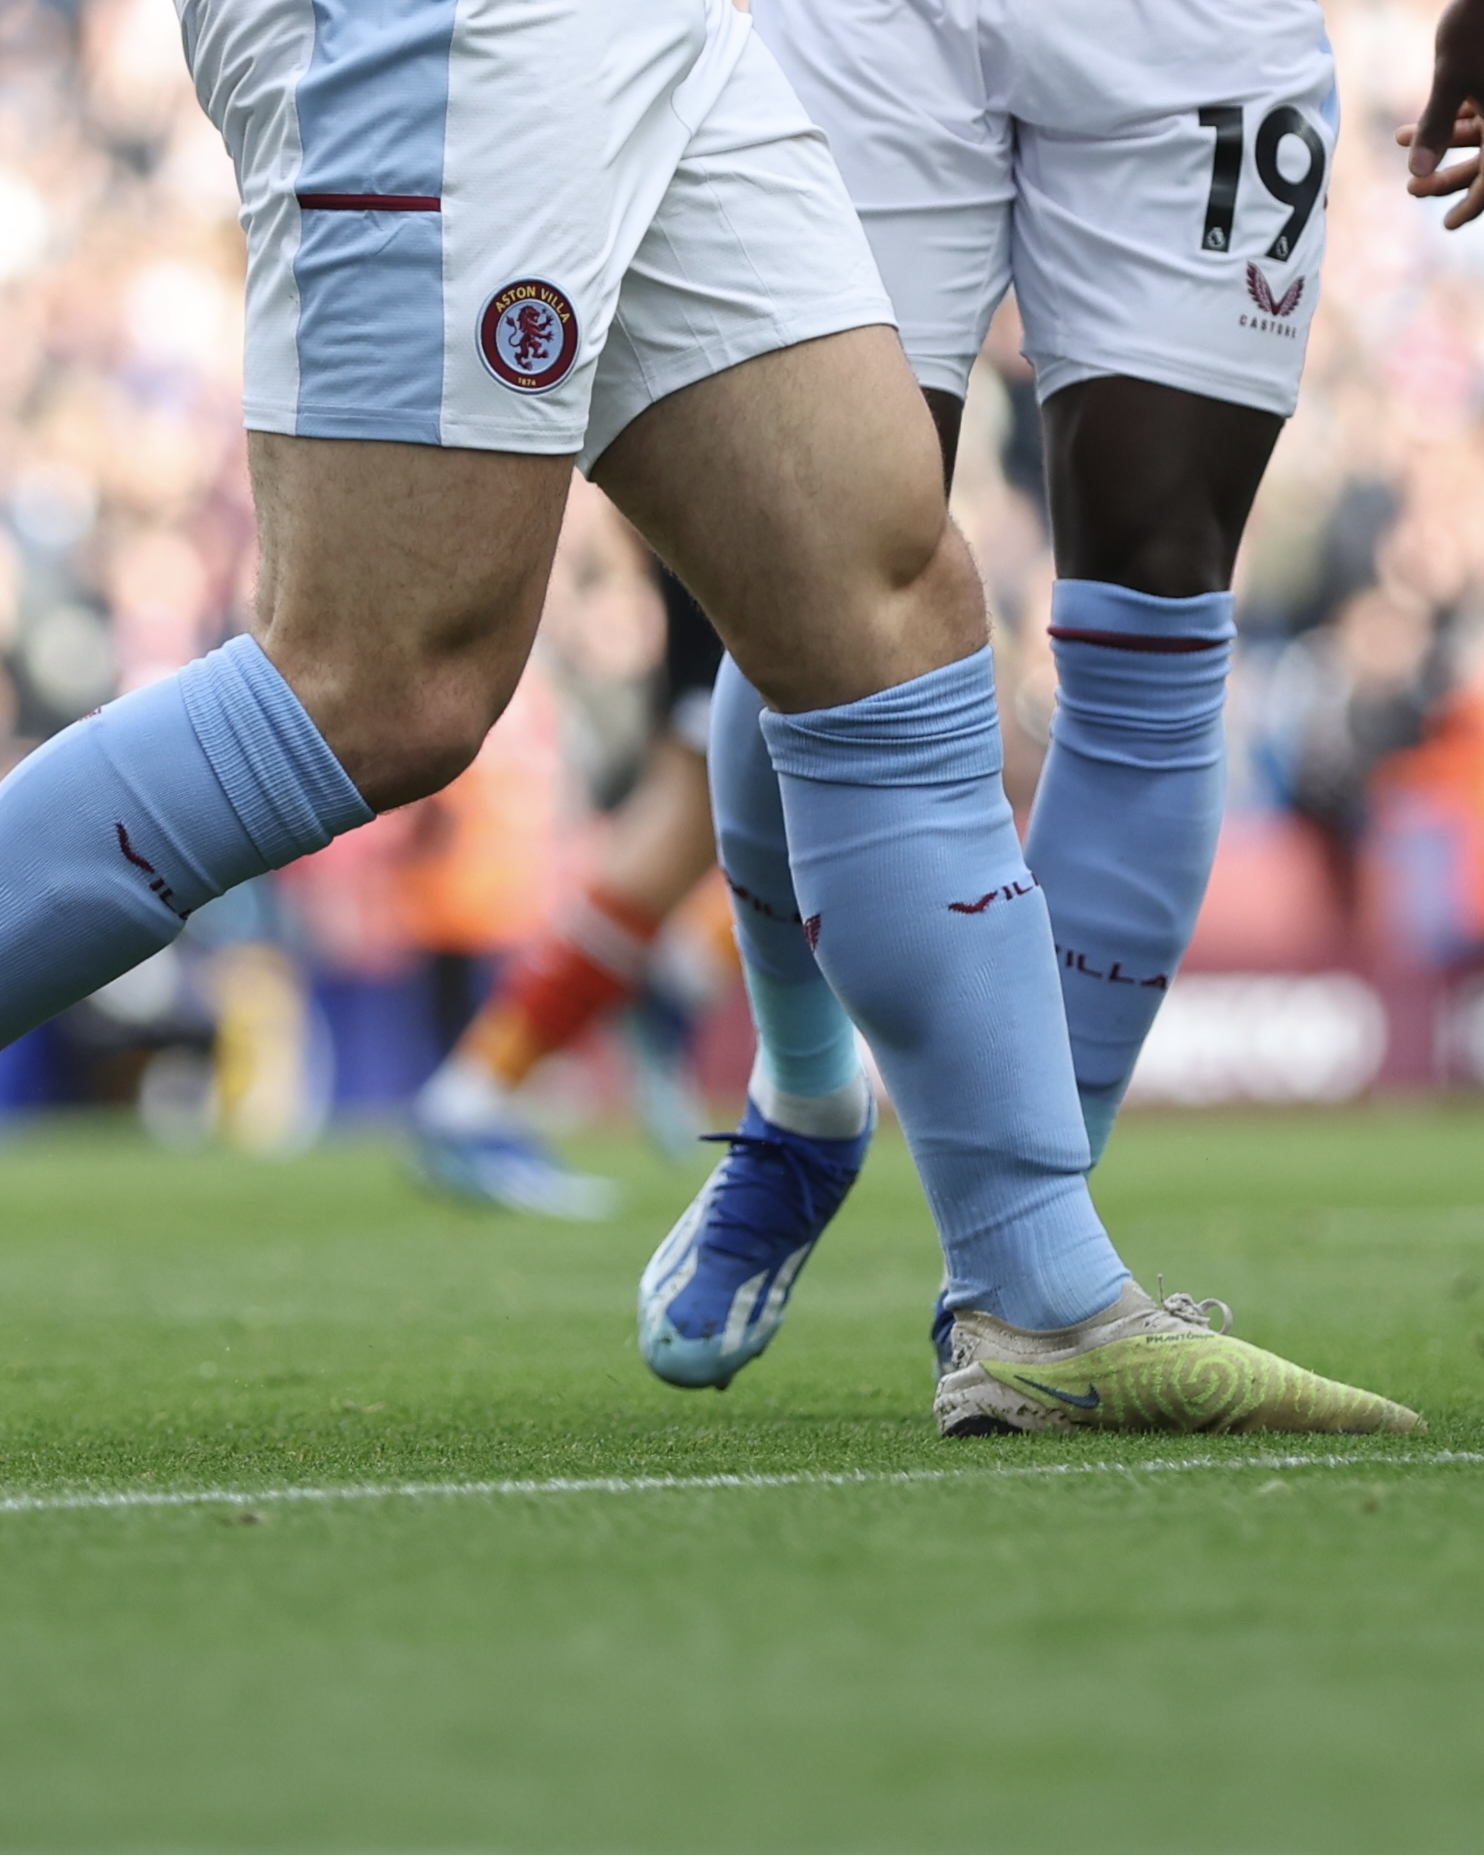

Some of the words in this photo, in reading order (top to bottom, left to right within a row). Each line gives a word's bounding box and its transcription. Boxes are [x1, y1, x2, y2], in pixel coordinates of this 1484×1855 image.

[1198, 104, 1326, 263] 19
[495, 286, 536, 313] ASTON
[541, 288, 571, 324] VILLA
[1239, 314, 1297, 339] CASTORE
